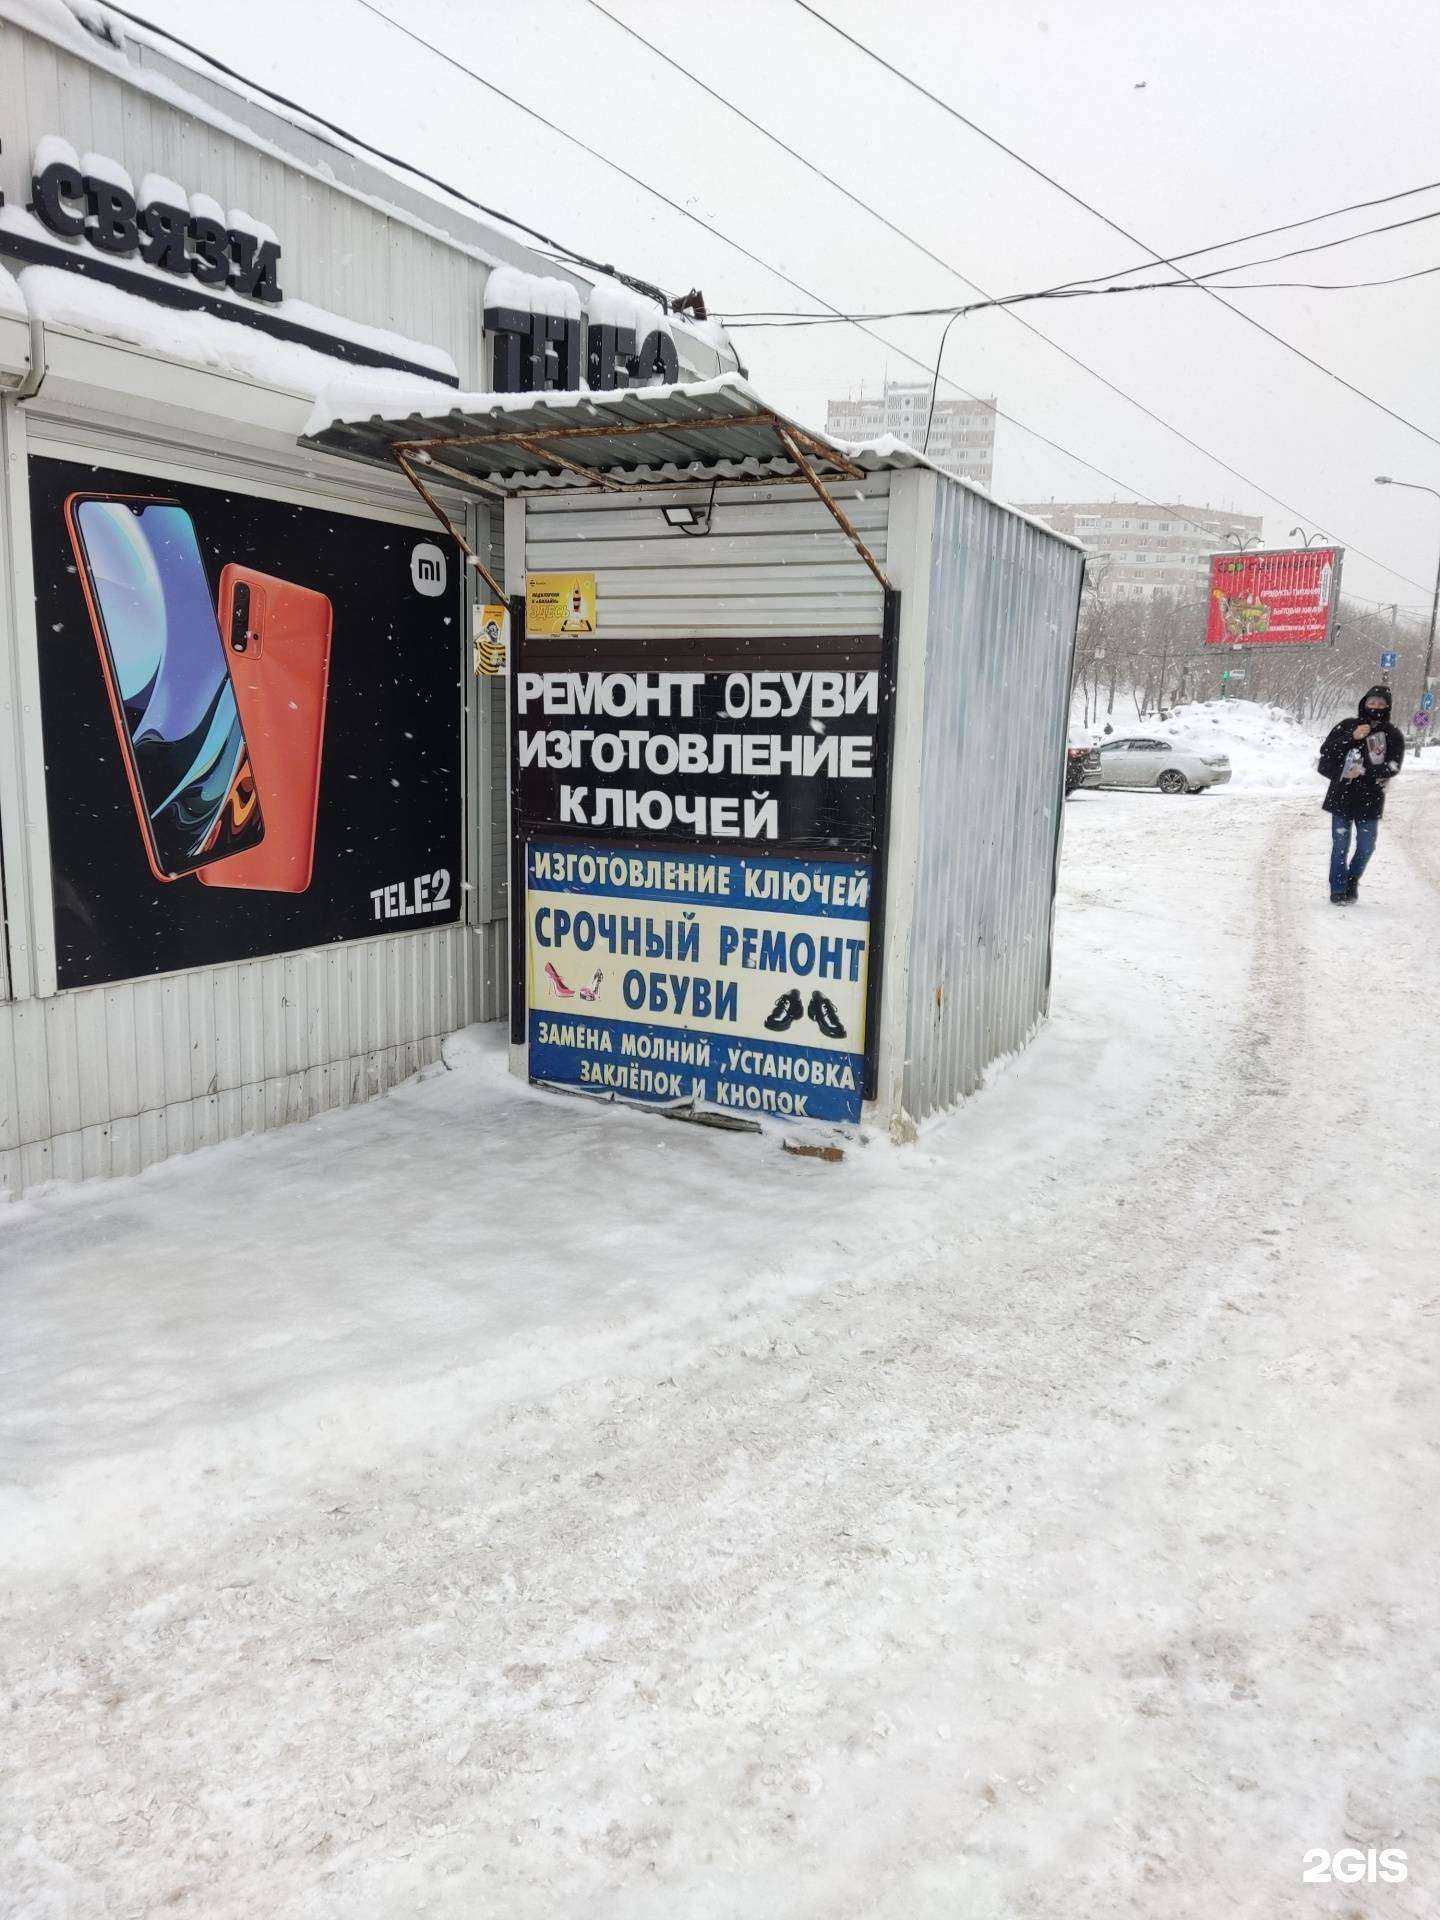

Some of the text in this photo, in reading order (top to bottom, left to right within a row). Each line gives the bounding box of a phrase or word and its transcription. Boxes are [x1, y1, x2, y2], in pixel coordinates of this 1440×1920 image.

[28, 162, 282, 302] СВЯЗИ
[517, 672, 878, 718] РЕМОНТ ОБУВИ
[519, 730, 873, 778] ИЗГОТОВЛЕНИЕ
[560, 785, 778, 839] КЛЮЧЕЙ
[370, 868, 451, 920] TELE2
[534, 851, 868, 908] ИЗГОТОВЛЕНИЕ КЛЮЧЕЙ
[534, 907, 865, 982] СРОЧНЫЙ РЕМОНТ
[623, 969, 738, 1022] ОБУВИ
[537, 1021, 612, 1053] ЗАМЕНА
[621, 1034, 710, 1067] МОЛНИЙ
[580, 1060, 808, 1117] ЗАКЛЁПОК И КНОПОК
